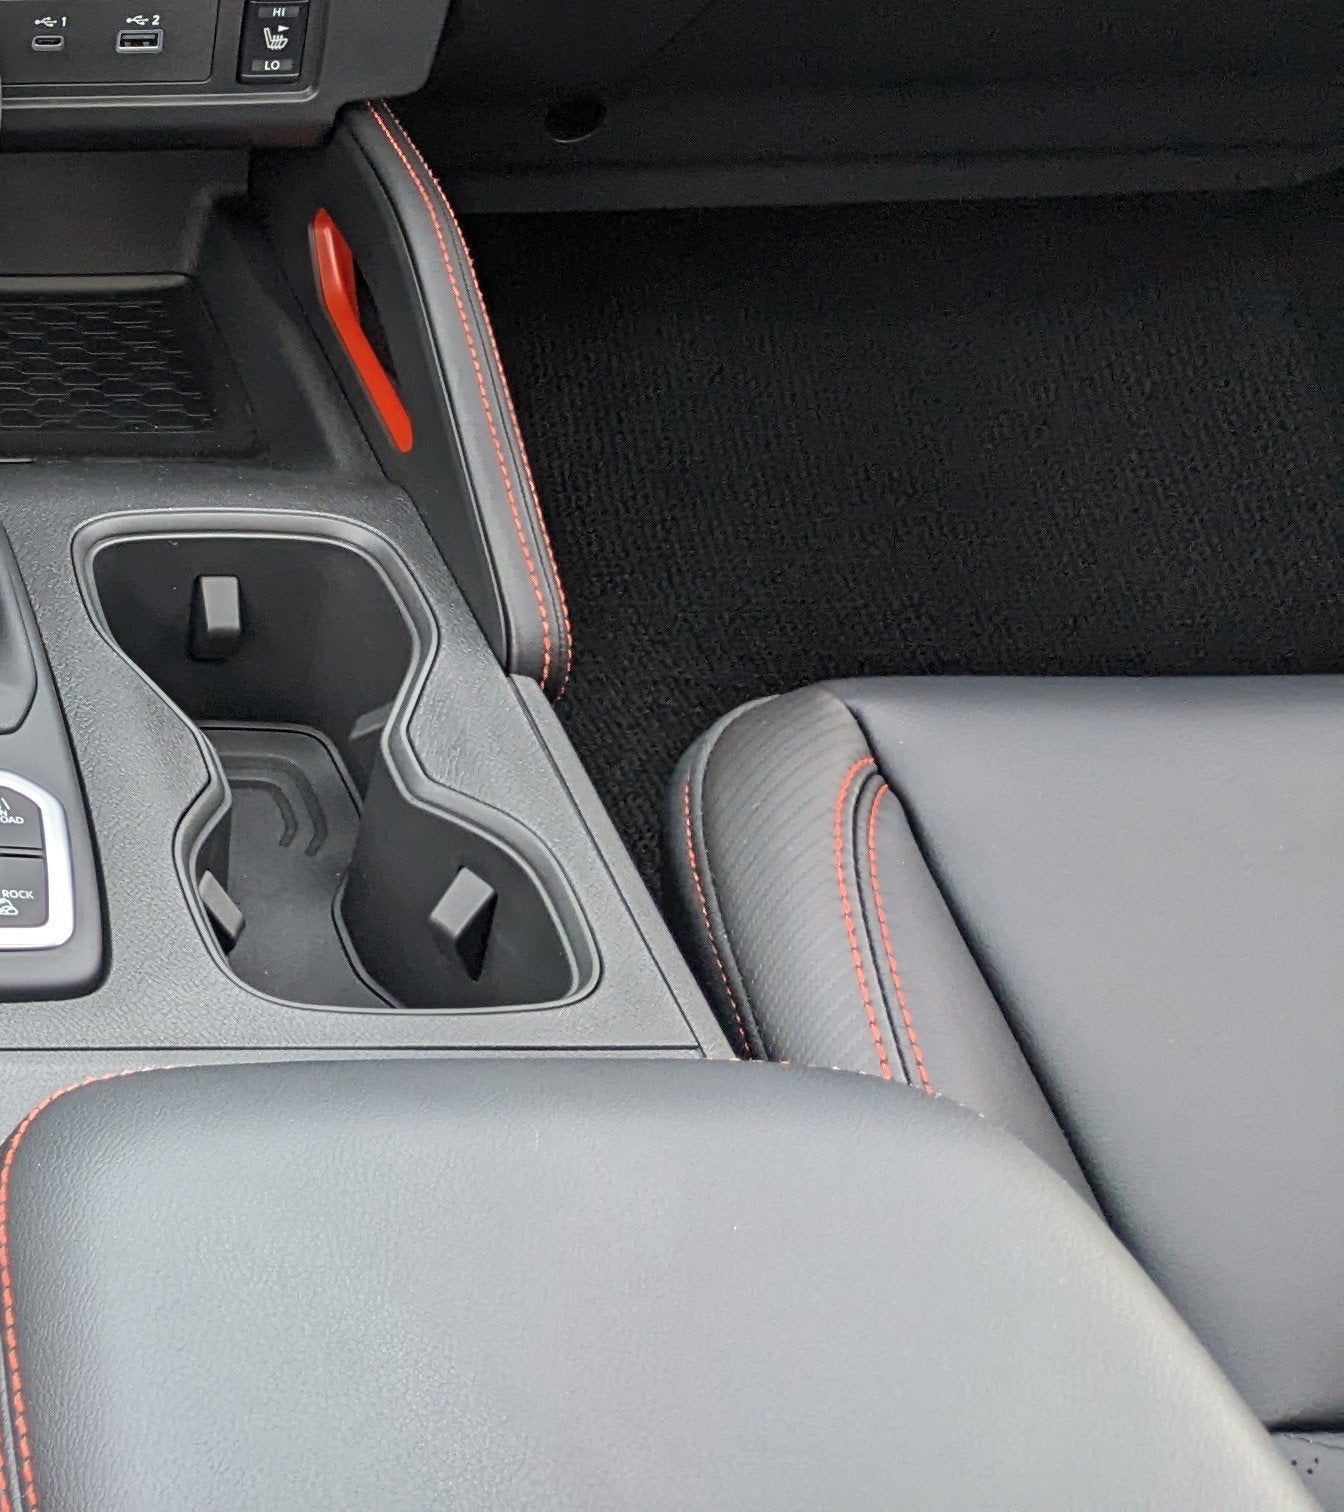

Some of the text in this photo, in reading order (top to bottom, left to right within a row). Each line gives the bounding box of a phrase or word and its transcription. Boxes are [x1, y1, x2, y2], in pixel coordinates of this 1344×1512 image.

[272, 7, 285, 17] HI
[151, 14, 160, 26] 2
[264, 60, 280, 70] LO
[1, 889, 34, 900] ROCK
